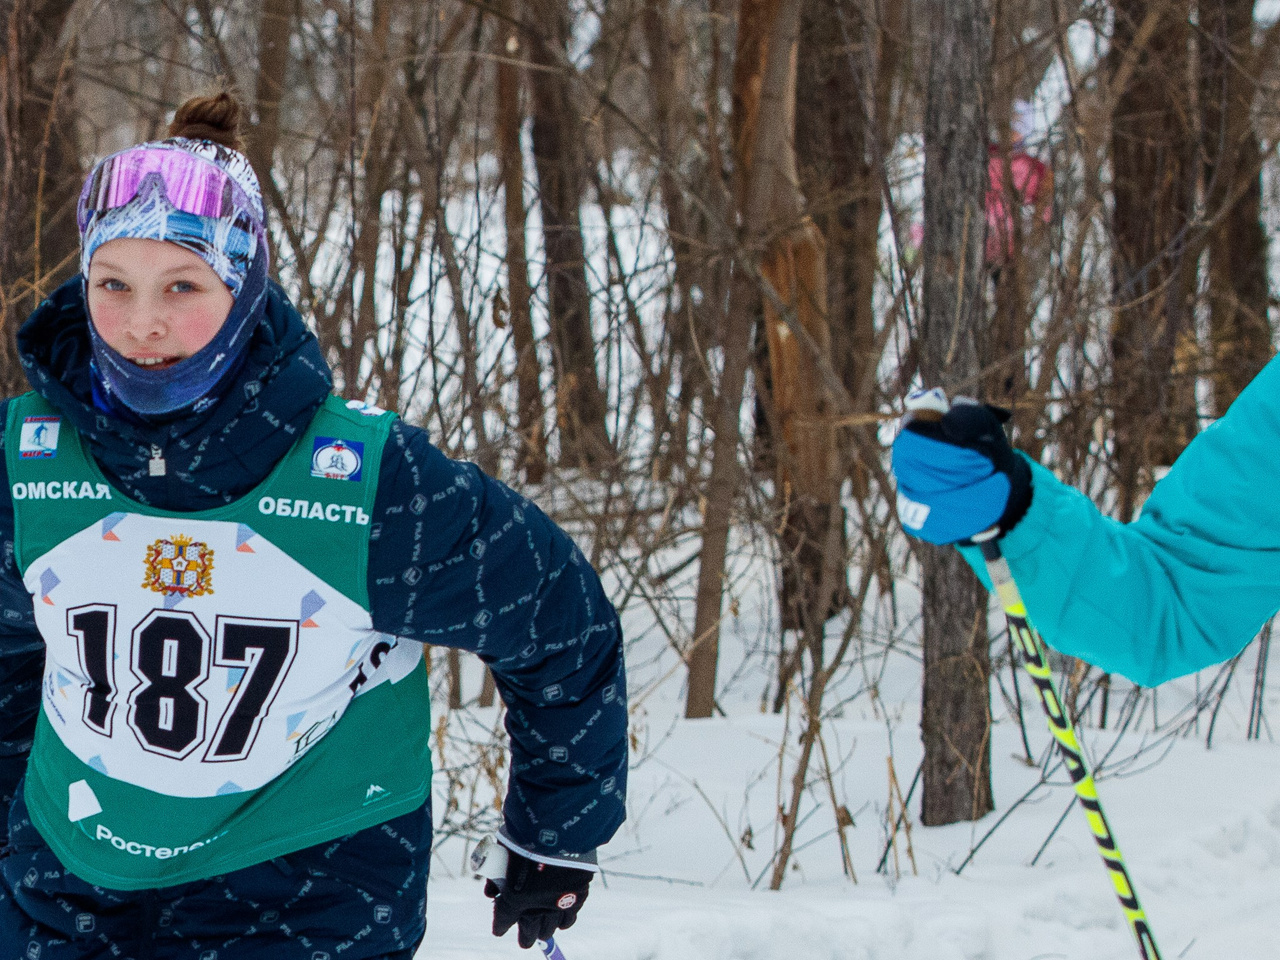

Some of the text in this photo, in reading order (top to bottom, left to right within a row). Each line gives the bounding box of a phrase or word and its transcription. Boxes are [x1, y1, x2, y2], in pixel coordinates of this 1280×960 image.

[12, 481, 371, 525] ОМСКАЯ ОБЛАСТЬ
[66, 602, 300, 764] 187
